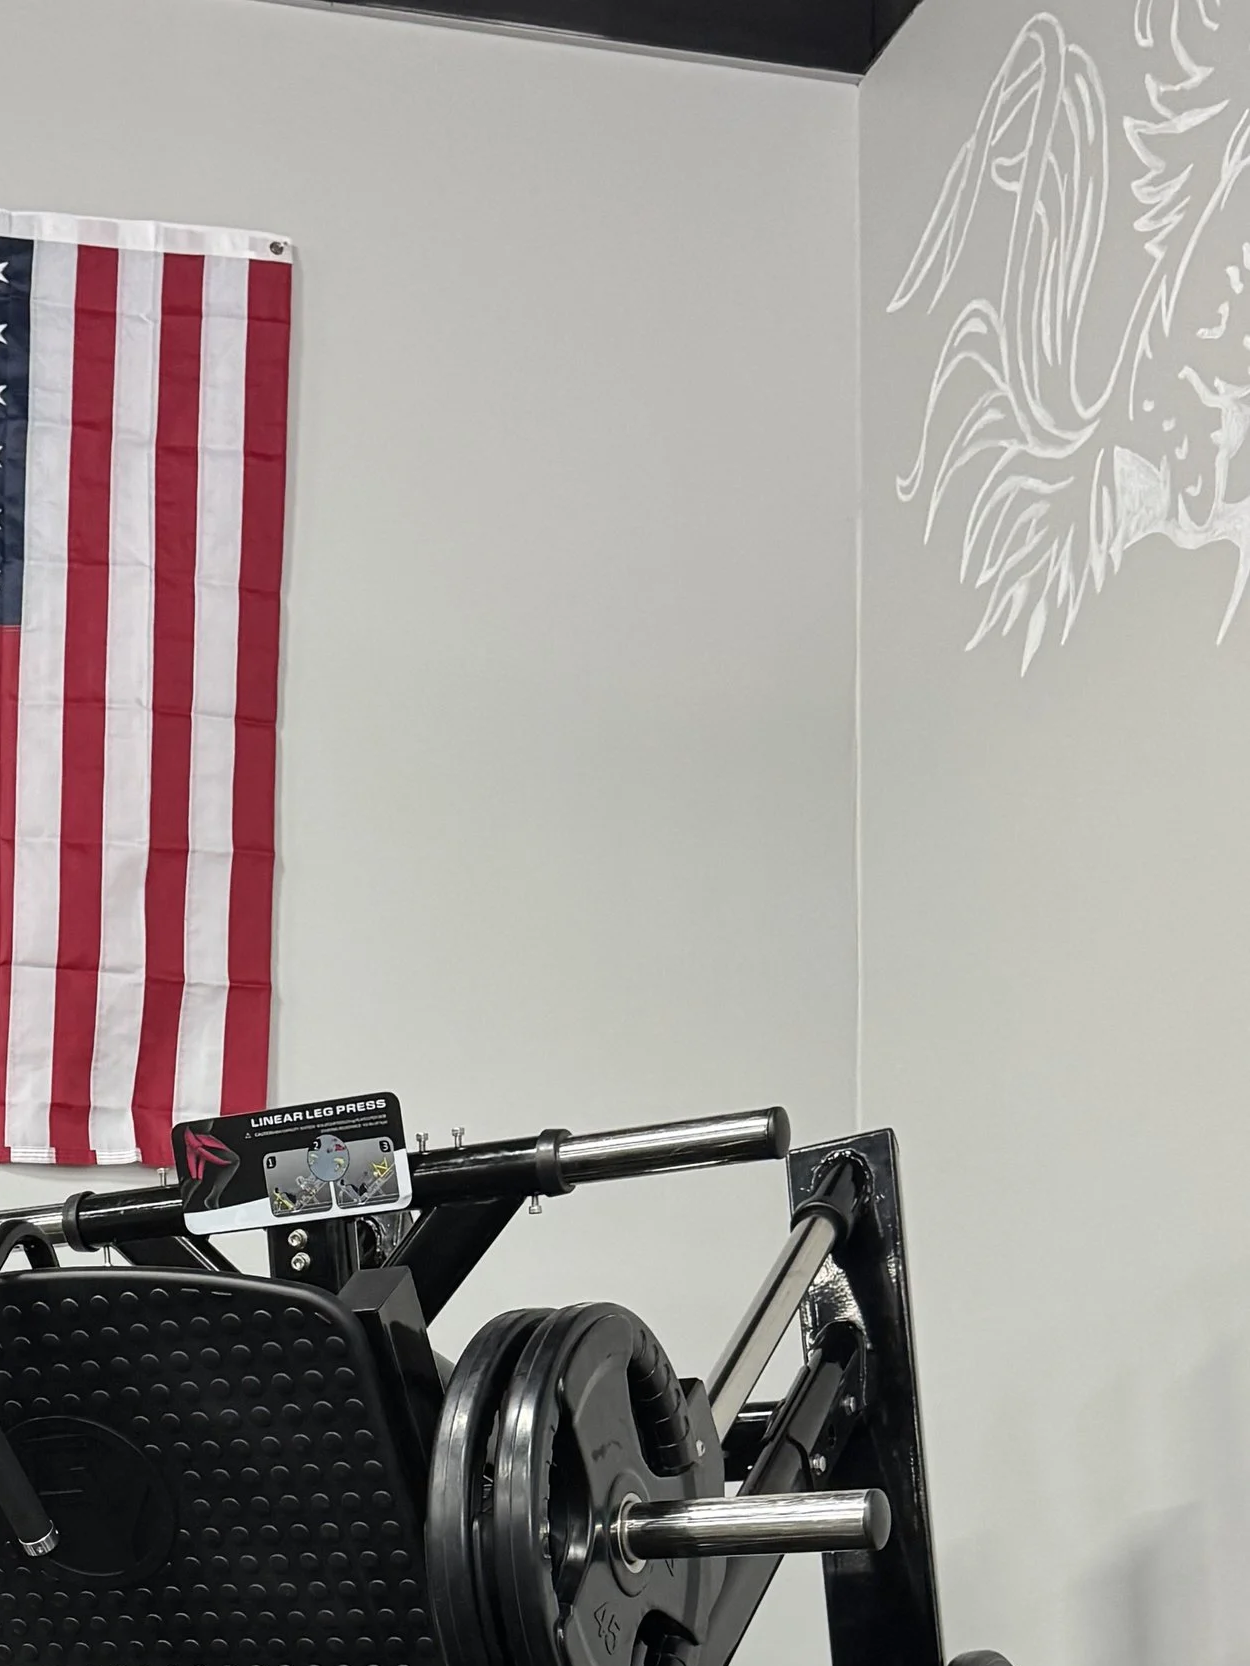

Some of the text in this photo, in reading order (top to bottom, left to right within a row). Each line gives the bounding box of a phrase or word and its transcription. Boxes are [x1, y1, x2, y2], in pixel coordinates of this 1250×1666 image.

[250, 1111, 303, 1128] LINEAR
[305, 1106, 334, 1120] LEG
[336, 1099, 387, 1115] PRESS
